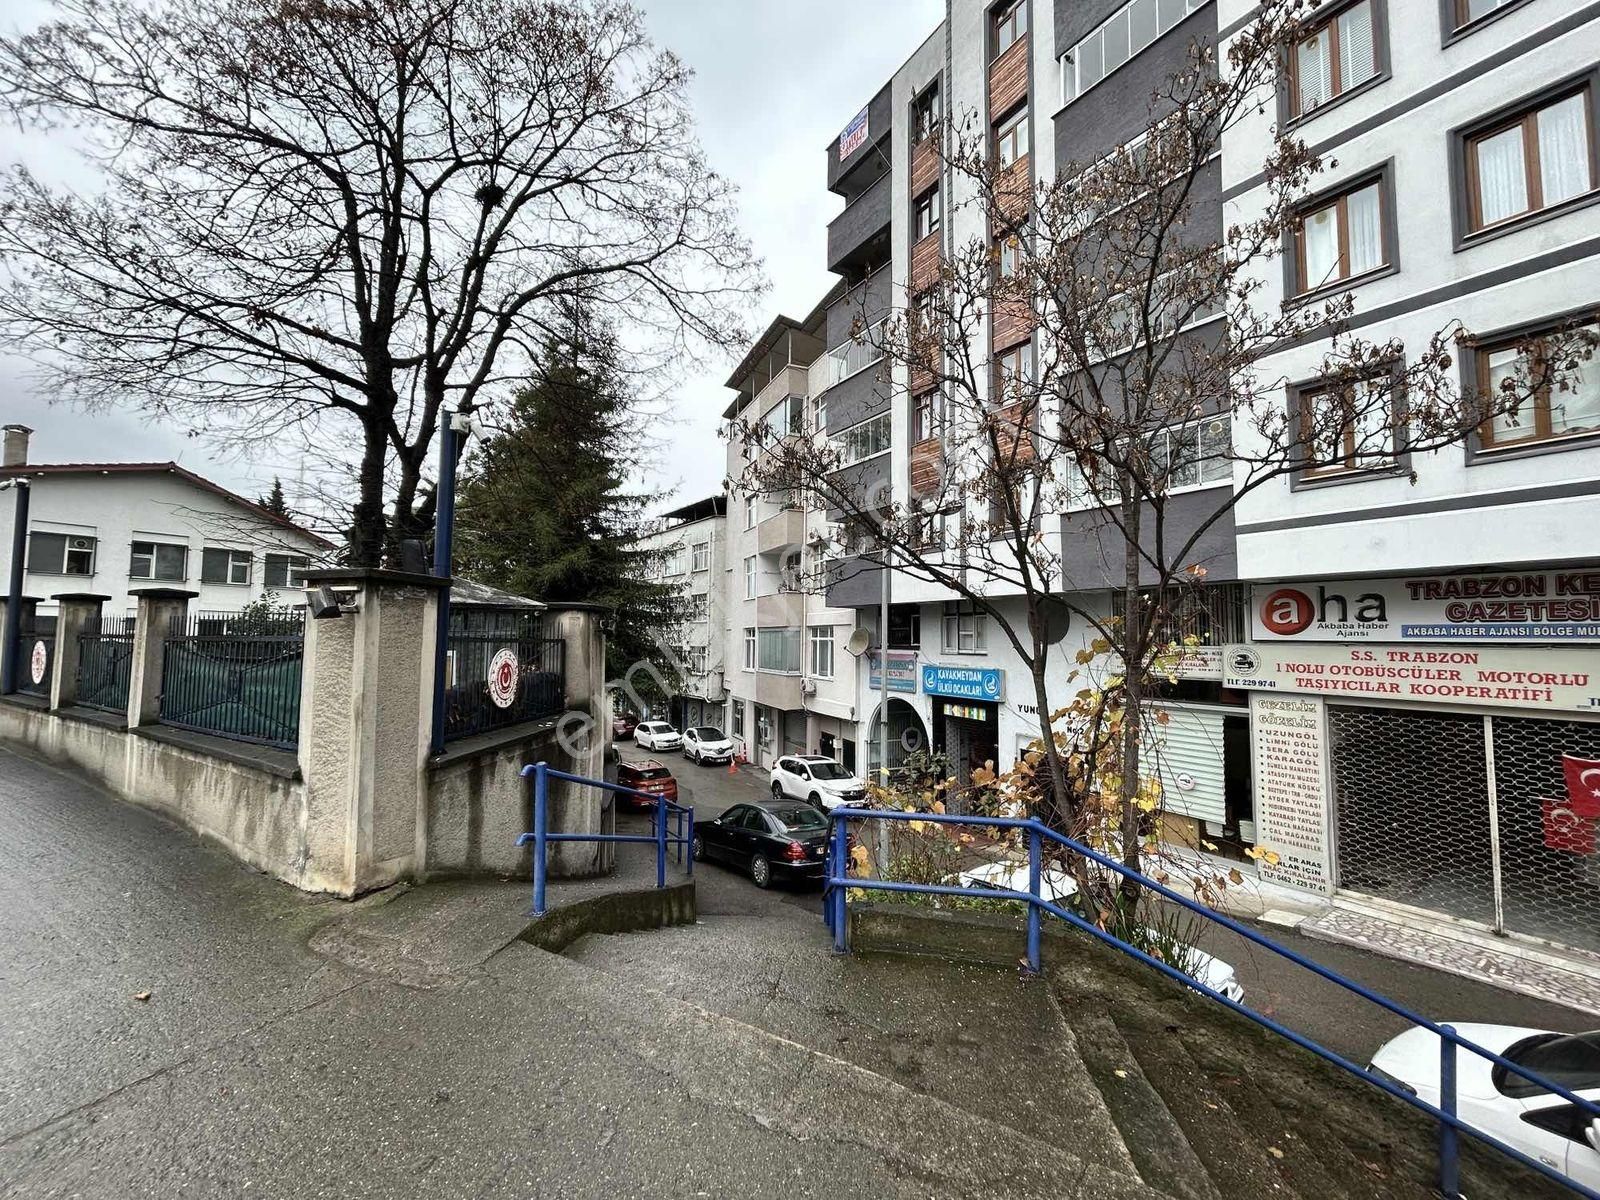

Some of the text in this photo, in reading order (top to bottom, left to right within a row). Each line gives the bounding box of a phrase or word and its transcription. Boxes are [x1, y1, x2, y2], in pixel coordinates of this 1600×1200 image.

[1405, 575, 1547, 600] TRABZON
[1317, 622, 1389, 630] Akbaba Haber
[1407, 627, 1448, 636] AKBABA
[1450, 627, 1486, 636] HABER
[1489, 627, 1530, 637] AJANSI
[1336, 630, 1369, 638] Ajansı
[1351, 650, 1479, 665] S.S. TRABZON
[1276, 663, 1590, 687] 1 NOLU OTOBÜSCÜLER MOTORLU
[937, 680, 982, 697] ÜLKÜ OCAKLARI
[1242, 679, 1257, 687] 229
[1295, 677, 1553, 703] TAŞIYICILAR KOOPERATİFİ
[1266, 746, 1290, 754] SERA
